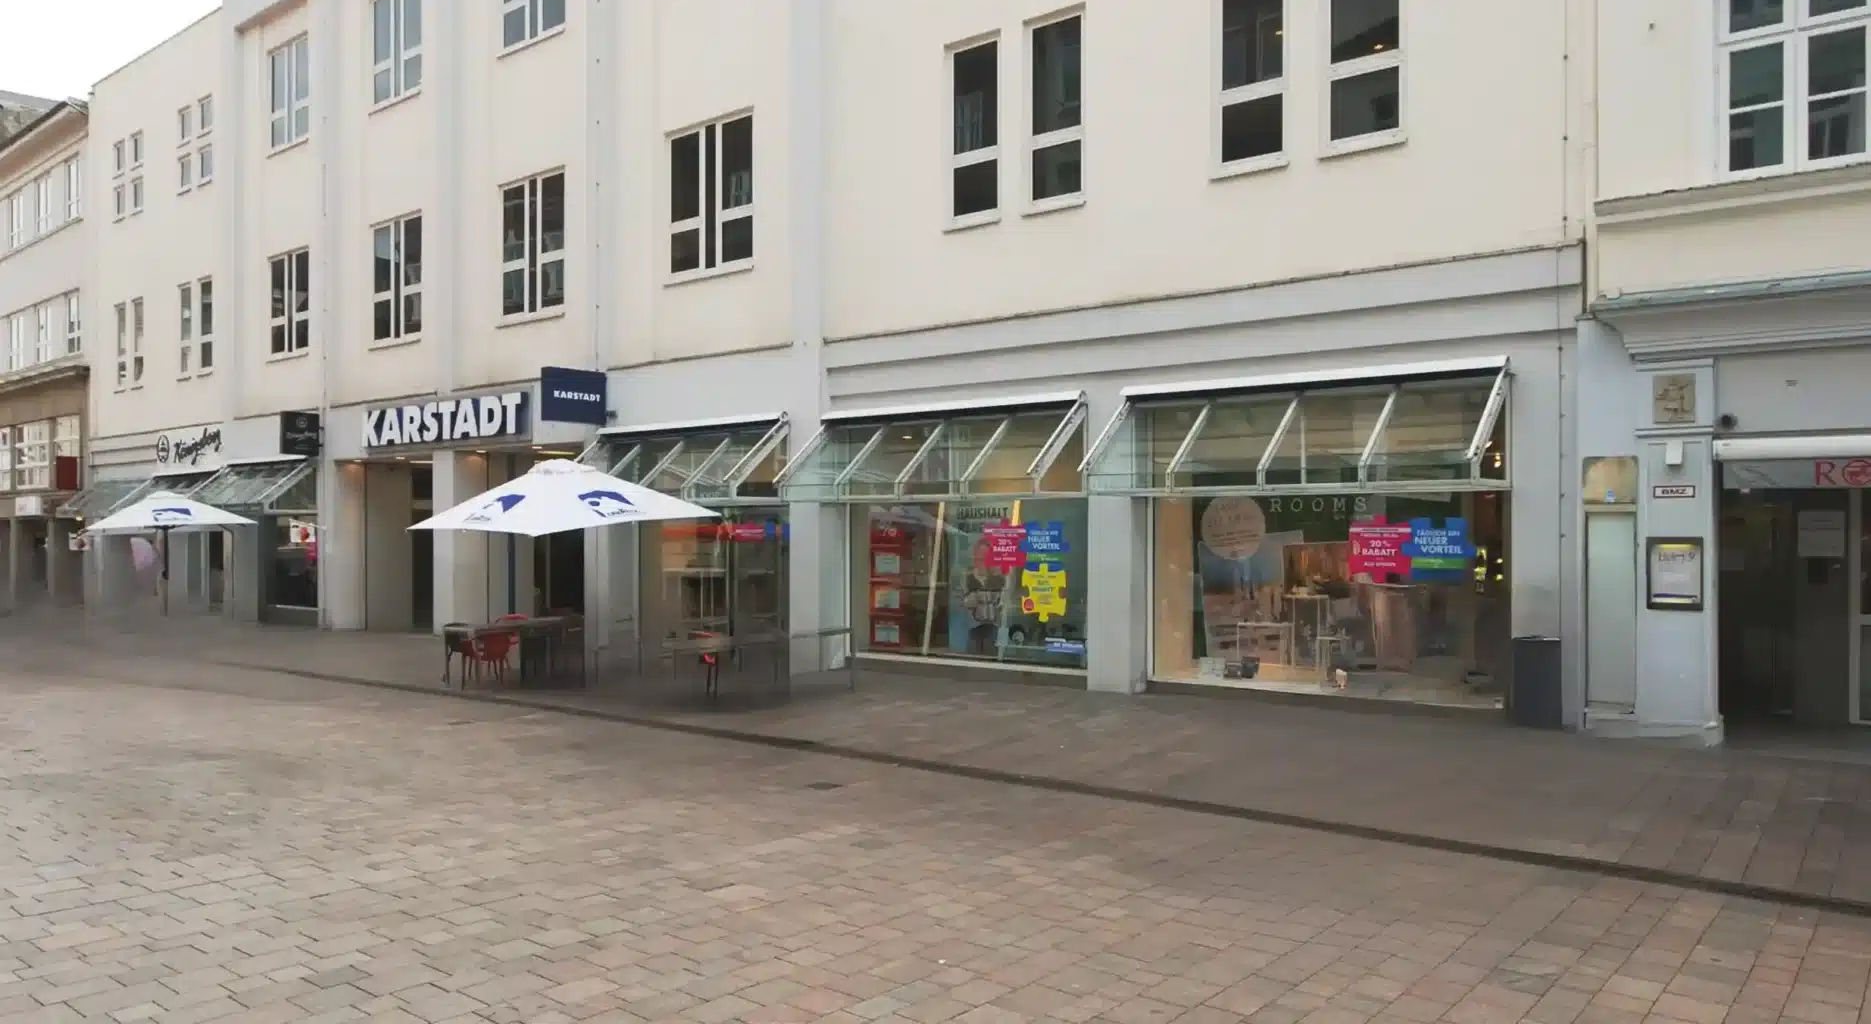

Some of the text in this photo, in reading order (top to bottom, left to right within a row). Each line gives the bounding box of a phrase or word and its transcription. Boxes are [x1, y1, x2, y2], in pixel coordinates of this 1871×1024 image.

[554, 390, 600, 403] KARSTADT
[362, 392, 521, 447] KARSTADT
[1660, 487, 1688, 495] BMZ
[1269, 496, 1367, 513] ROOMS
[1415, 537, 1448, 545] NEUER
[1362, 548, 1396, 556] RABATT
[1420, 545, 1463, 554] VORTEIL
